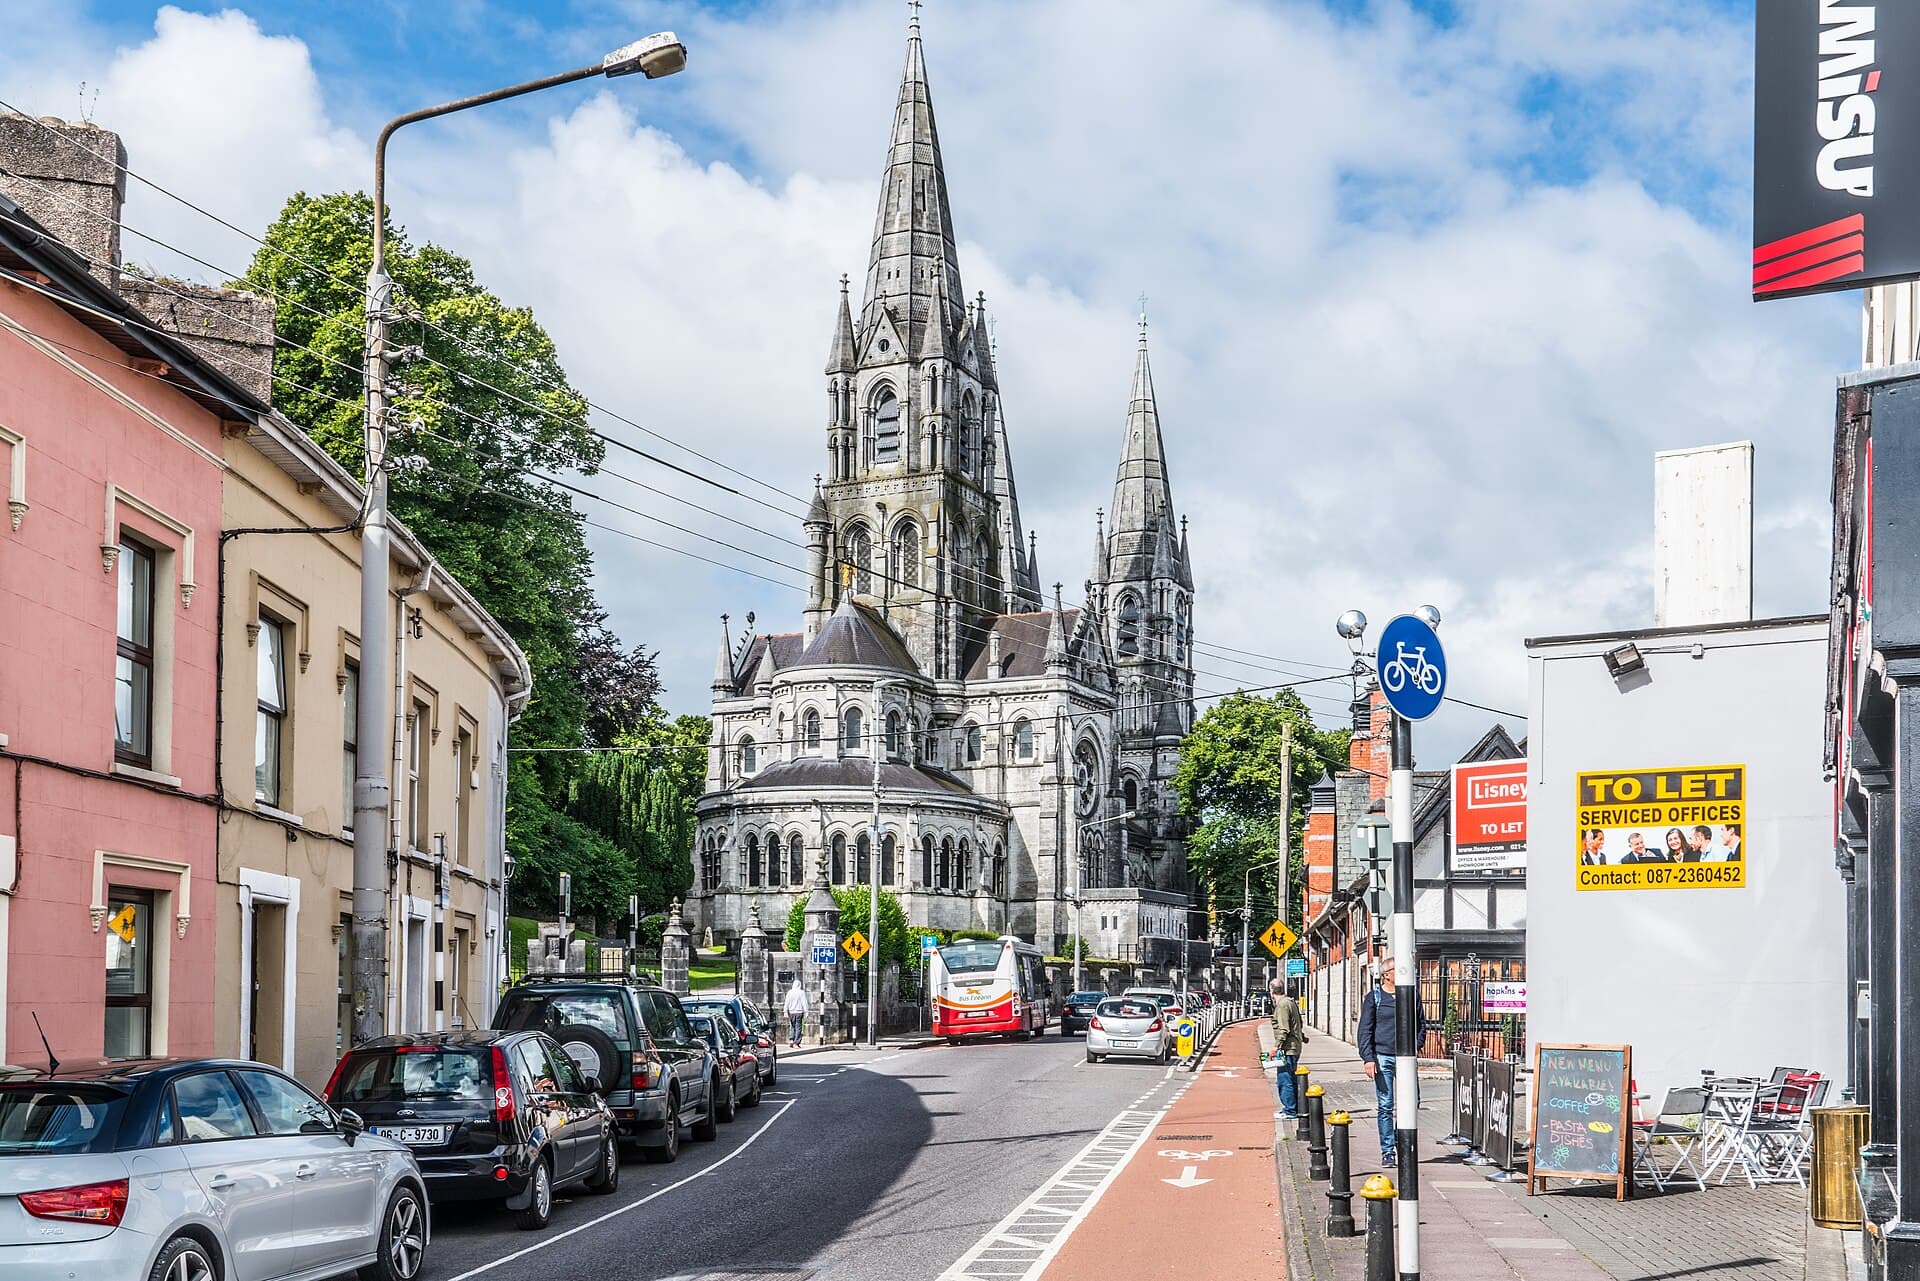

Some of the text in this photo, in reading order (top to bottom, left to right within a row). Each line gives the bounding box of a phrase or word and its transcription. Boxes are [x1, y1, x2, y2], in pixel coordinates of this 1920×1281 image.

[1474, 782, 1527, 800] Lisney
[1587, 772, 1735, 802] TO LET
[1580, 804, 1741, 826] SERVICED OFFICES
[1480, 821, 1524, 835] TO LET
[1580, 866, 1741, 885] Contact: 087-2360452
[1486, 985, 1516, 997] hopkins
[1549, 1097, 1590, 1115] COFFEE
[1550, 1119, 1588, 1135] PASTA
[1550, 1133, 1593, 1150] DISHES
